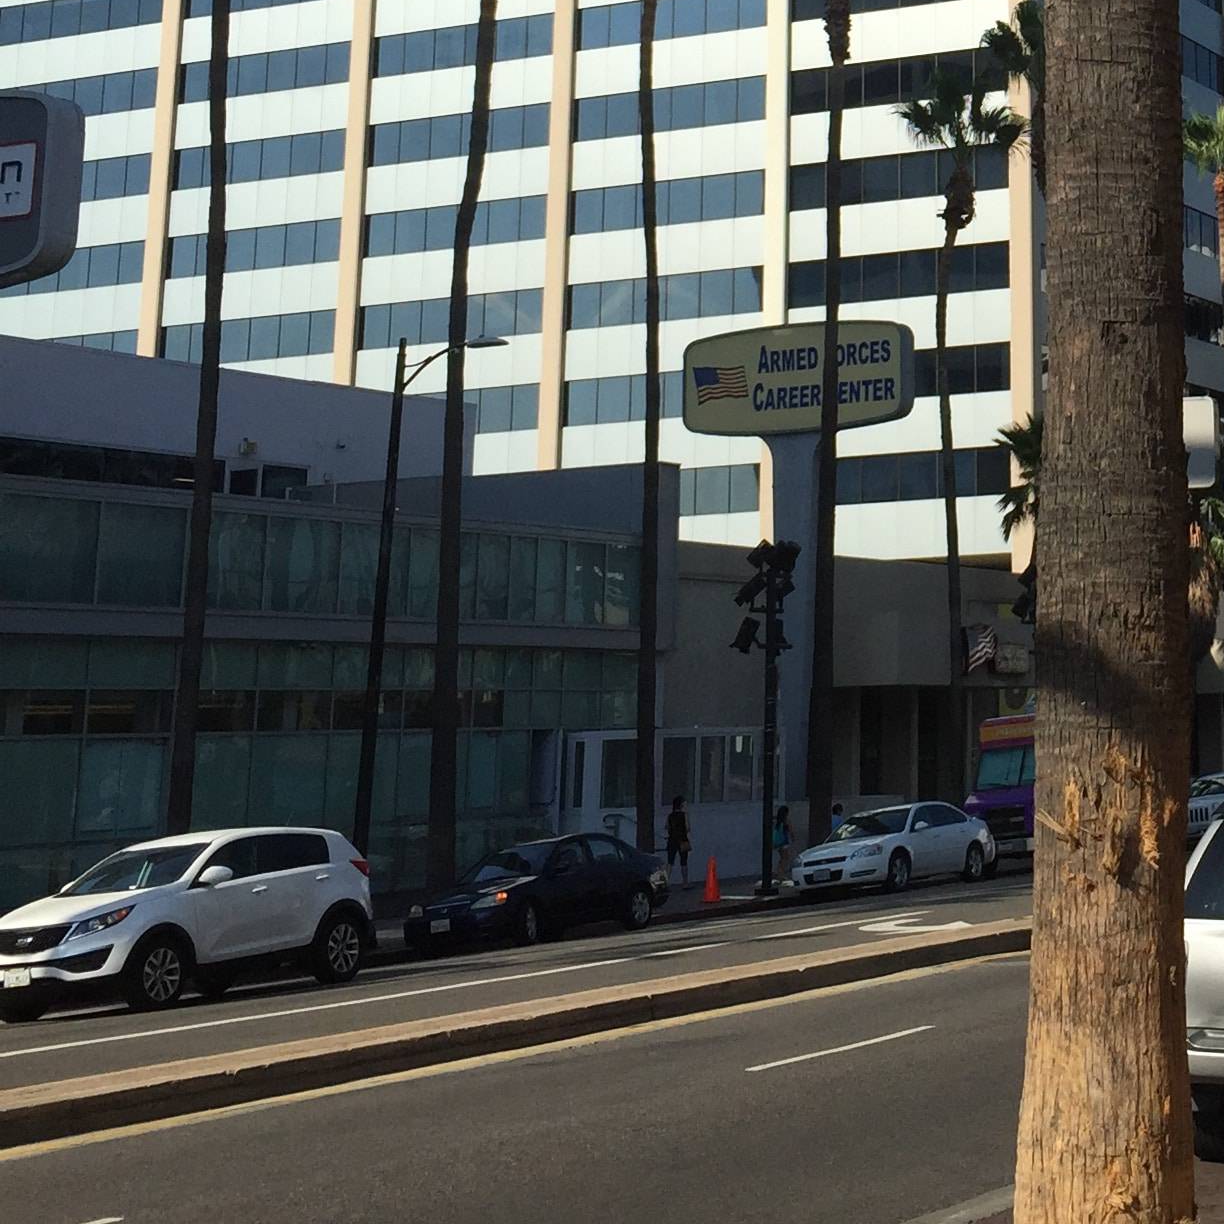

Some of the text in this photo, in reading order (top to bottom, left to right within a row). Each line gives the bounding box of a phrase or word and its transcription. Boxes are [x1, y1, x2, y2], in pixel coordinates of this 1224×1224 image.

[758, 340, 891, 374] ARMED ORCES
[753, 377, 895, 411] CAREER ENTER
